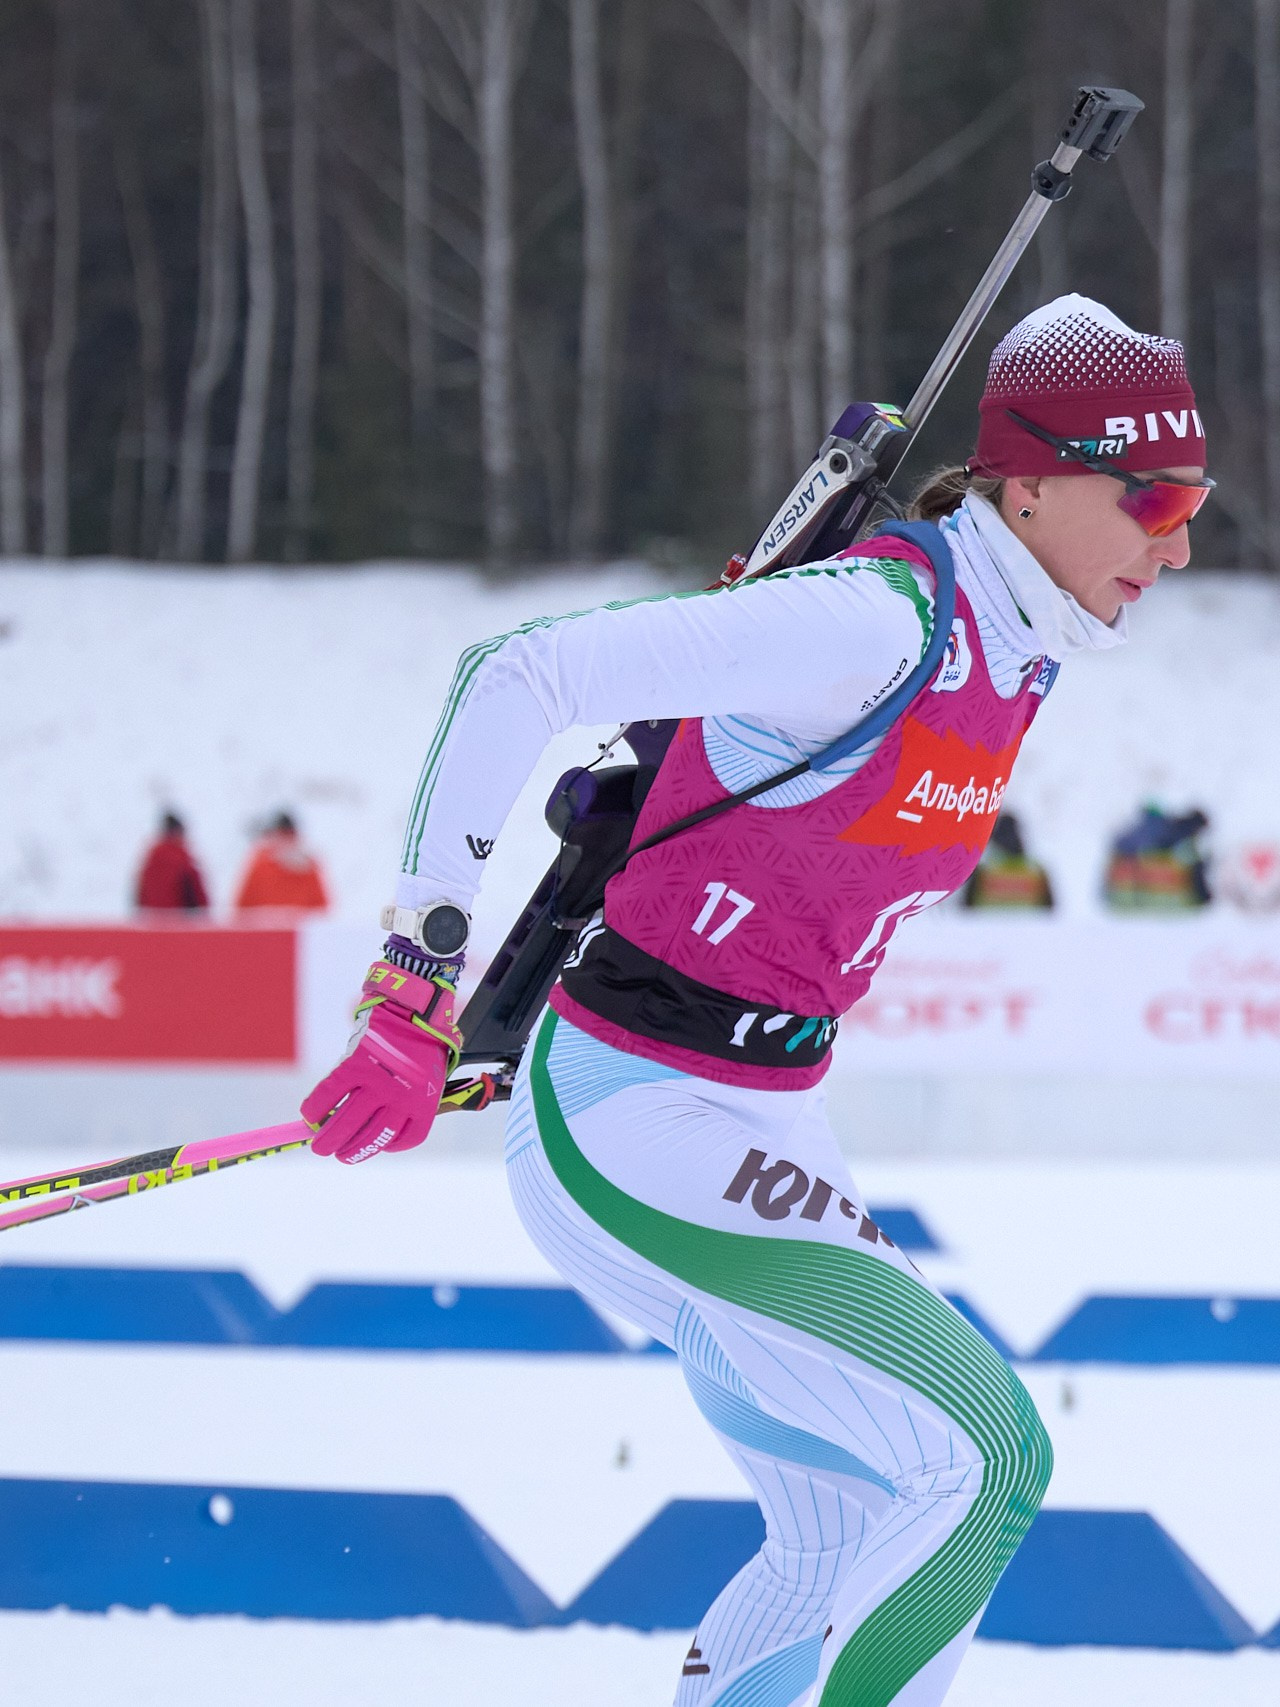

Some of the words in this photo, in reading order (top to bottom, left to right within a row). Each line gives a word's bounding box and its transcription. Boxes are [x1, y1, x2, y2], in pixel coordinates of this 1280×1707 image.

[763, 470, 829, 556] LARSEN
[872, 658, 908, 702] CRAFT
[904, 769, 988, 823] Альфа
[692, 882, 756, 946] 17
